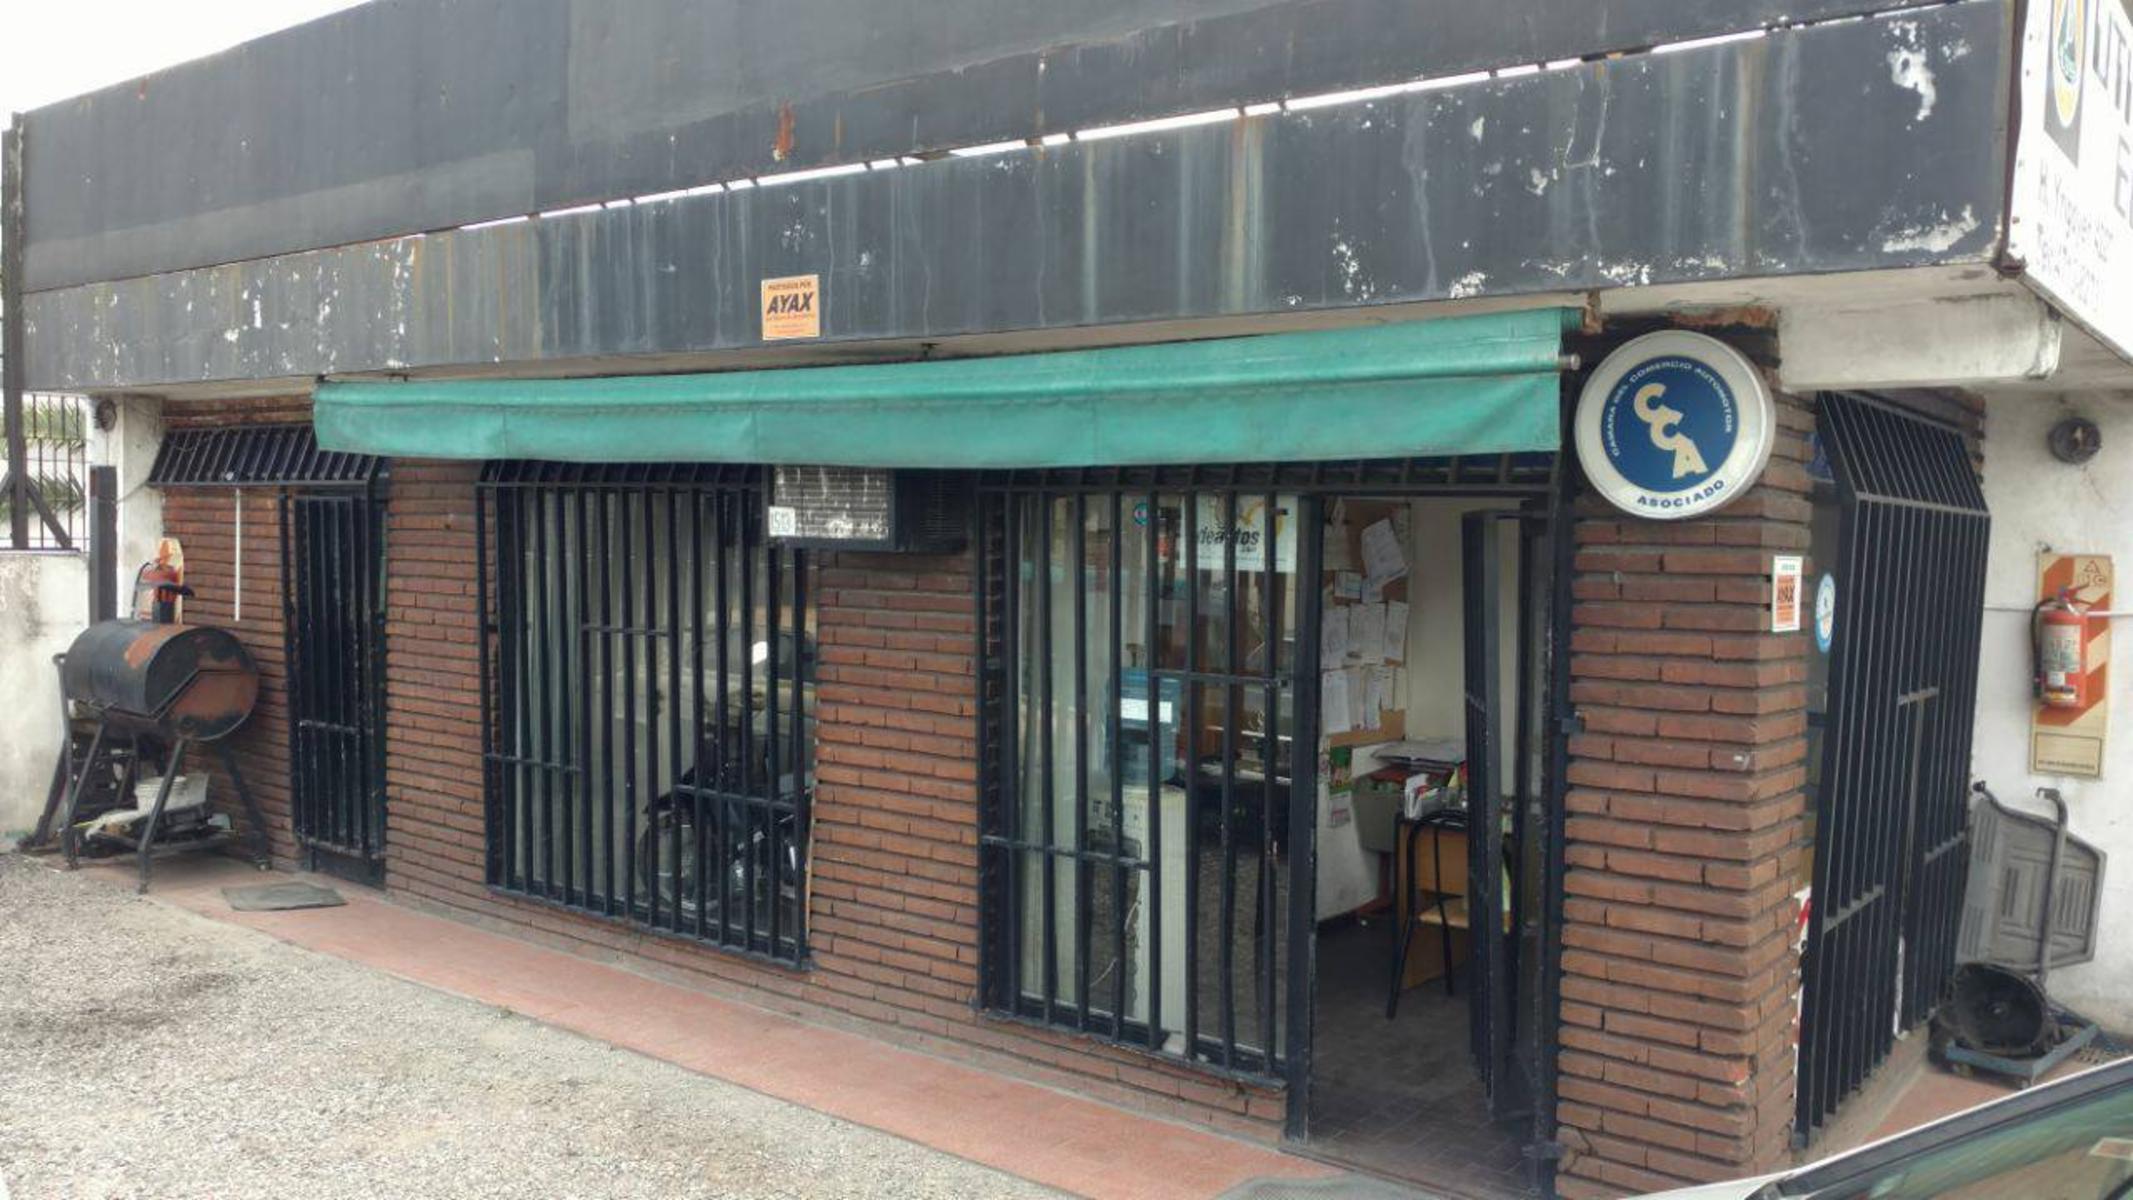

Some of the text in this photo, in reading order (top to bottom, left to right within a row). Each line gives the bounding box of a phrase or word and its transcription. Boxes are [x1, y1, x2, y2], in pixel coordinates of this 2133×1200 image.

[766, 291, 815, 314] AYAX
[1629, 360, 1692, 384] COMERCIO
[1633, 382, 1708, 479] CCA
[1636, 479, 1725, 509] ASOCIADO
